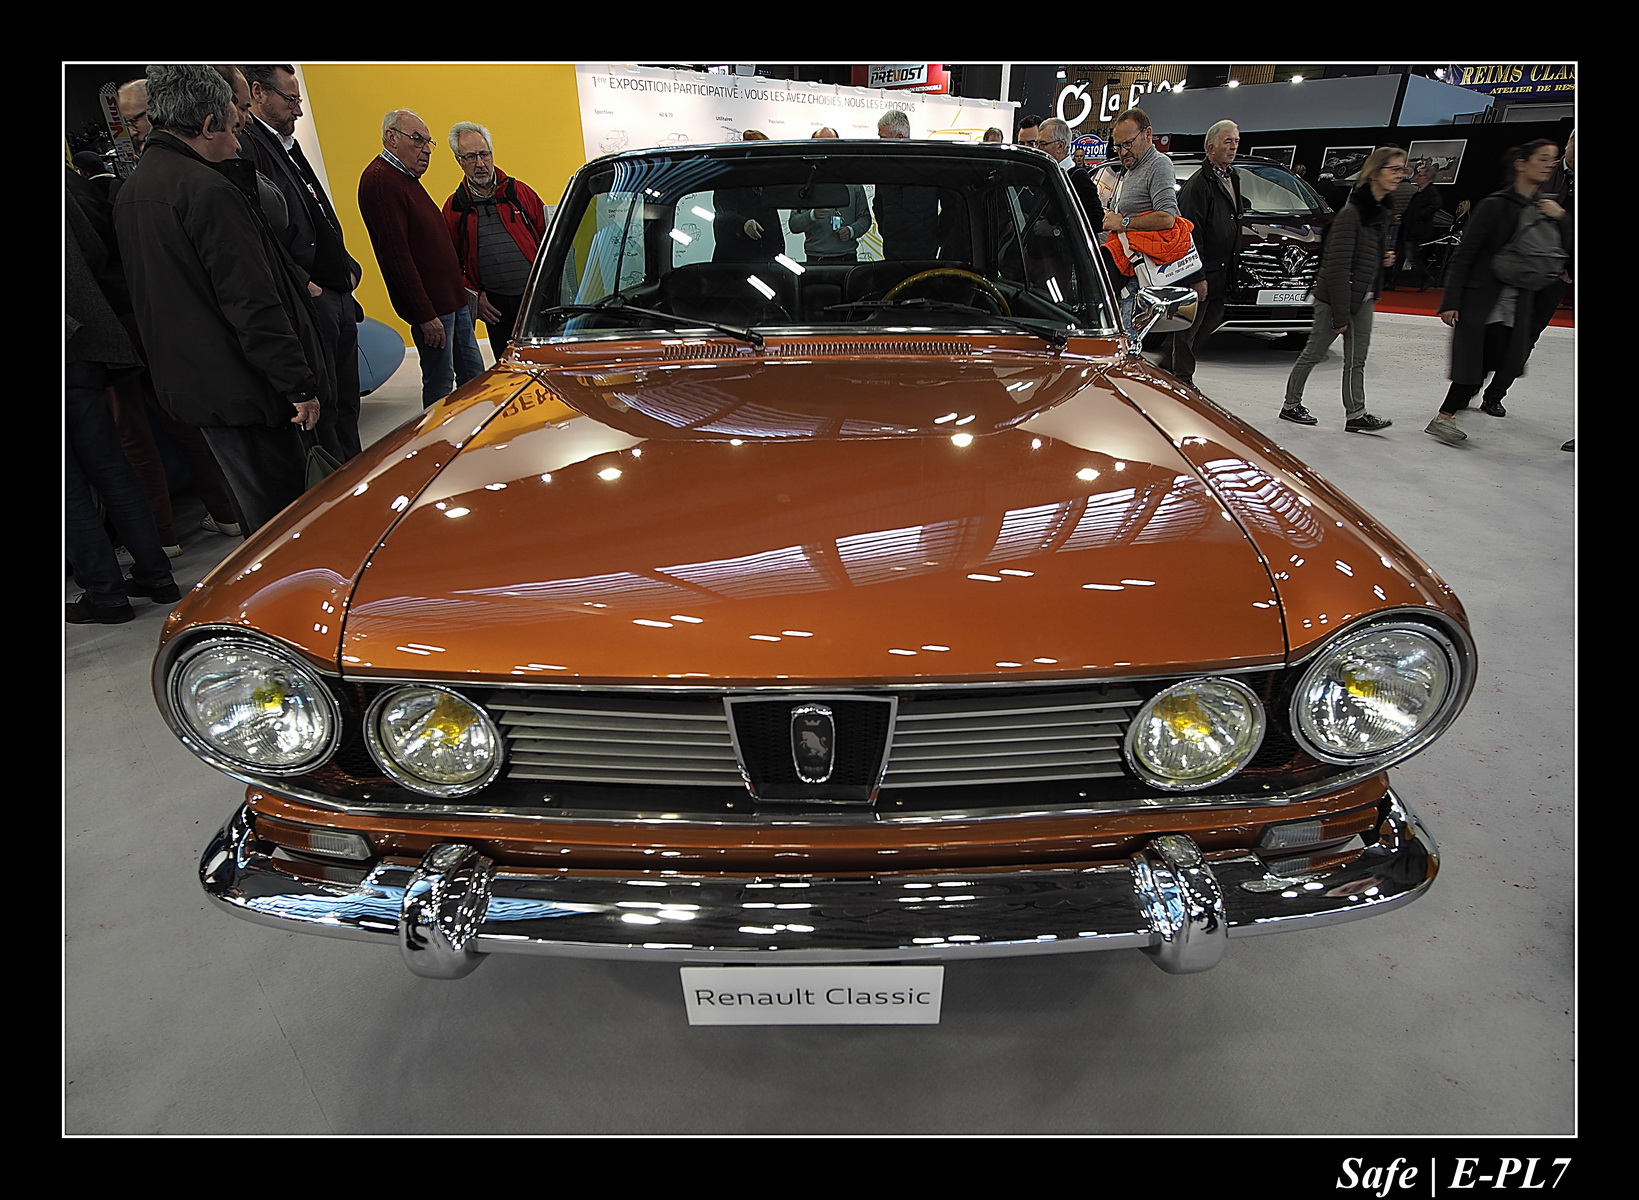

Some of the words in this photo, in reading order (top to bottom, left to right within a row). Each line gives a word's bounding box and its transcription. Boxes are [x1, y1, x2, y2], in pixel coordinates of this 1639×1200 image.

[1459, 64, 1524, 85] REIMS
[592, 76, 607, 87] 1ère
[609, 77, 672, 93] EXPOSITION
[673, 82, 739, 99] PARTICIPATIVE
[744, 89, 769, 101] VOUS
[770, 91, 785, 102] LES
[786, 92, 807, 104] AVEZ
[844, 97, 866, 109] NOUS
[866, 99, 879, 109] LES
[880, 100, 916, 112] EXPOSONS
[1489, 86, 1532, 94] ATELIER
[594, 108, 614, 116] Sportives
[1099, 84, 1121, 122] La
[1273, 294, 1306, 302] ESPACE
[694, 988, 815, 1006] Renault
[825, 988, 931, 1005] Classic
